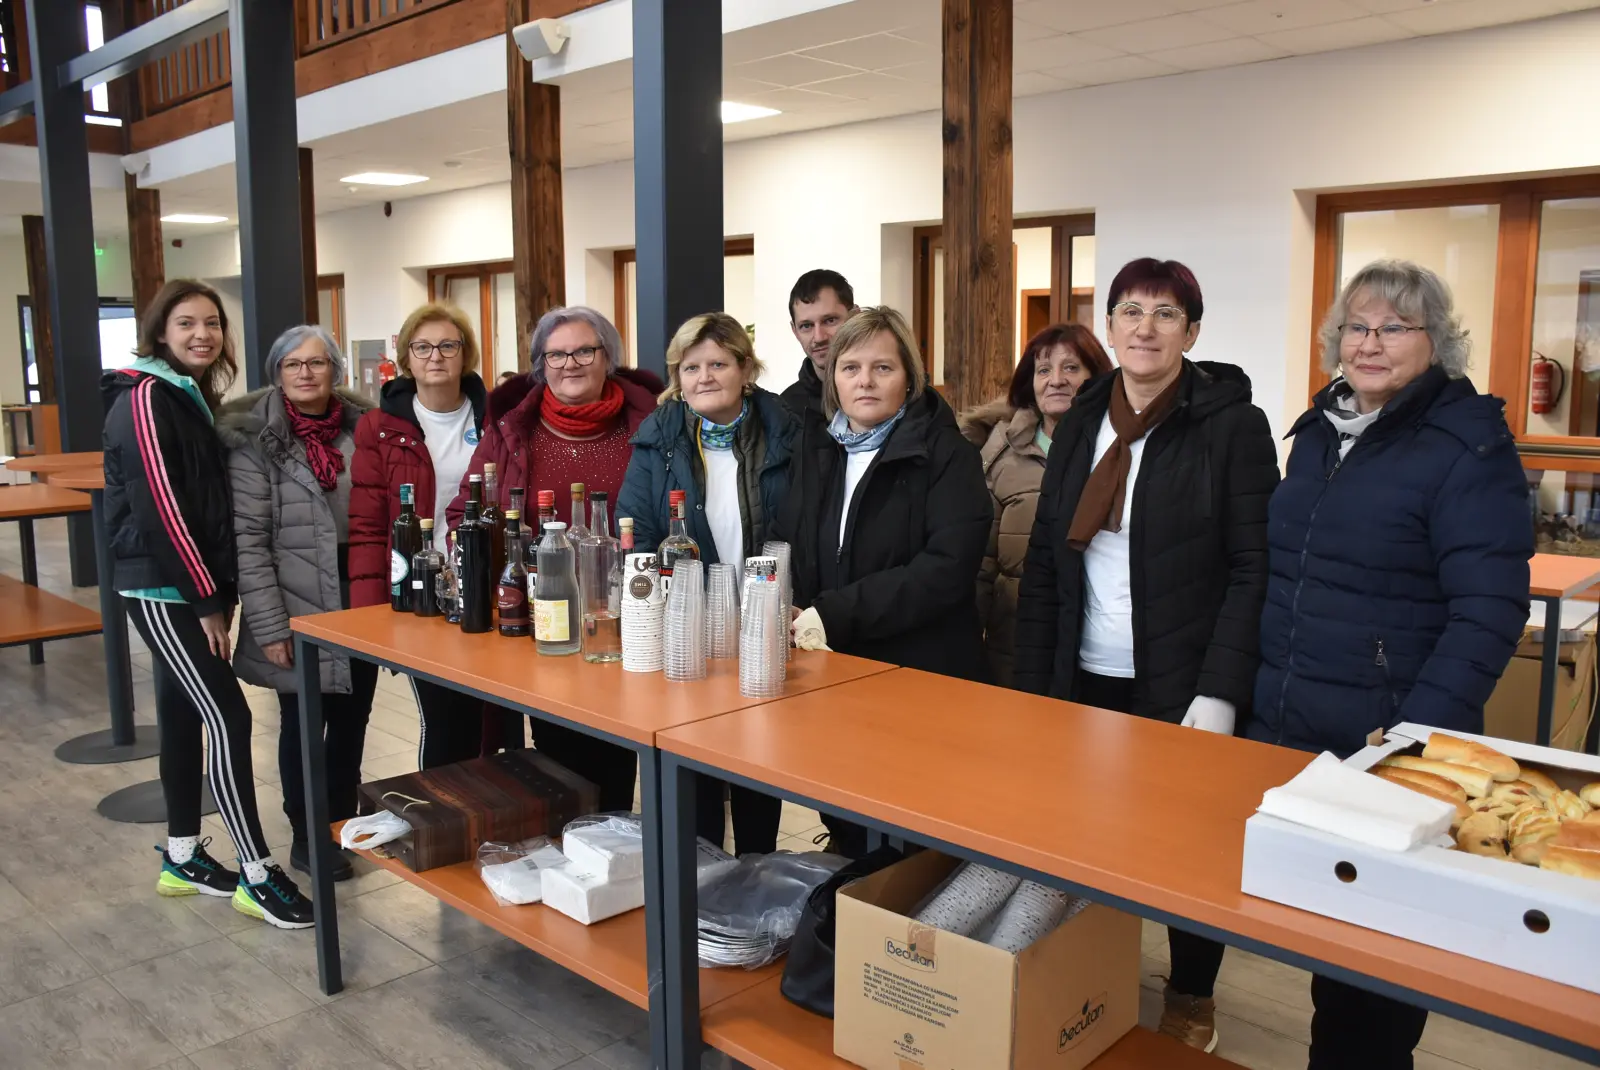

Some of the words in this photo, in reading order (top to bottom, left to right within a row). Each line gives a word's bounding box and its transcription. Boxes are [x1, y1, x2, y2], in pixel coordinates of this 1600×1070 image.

[887, 940, 935, 969] Becutan
[883, 976, 896, 984] WIPES
[896, 981, 908, 989] WITH
[1060, 1003, 1104, 1049] Becutan
[893, 1040, 925, 1055] ALKALOID
